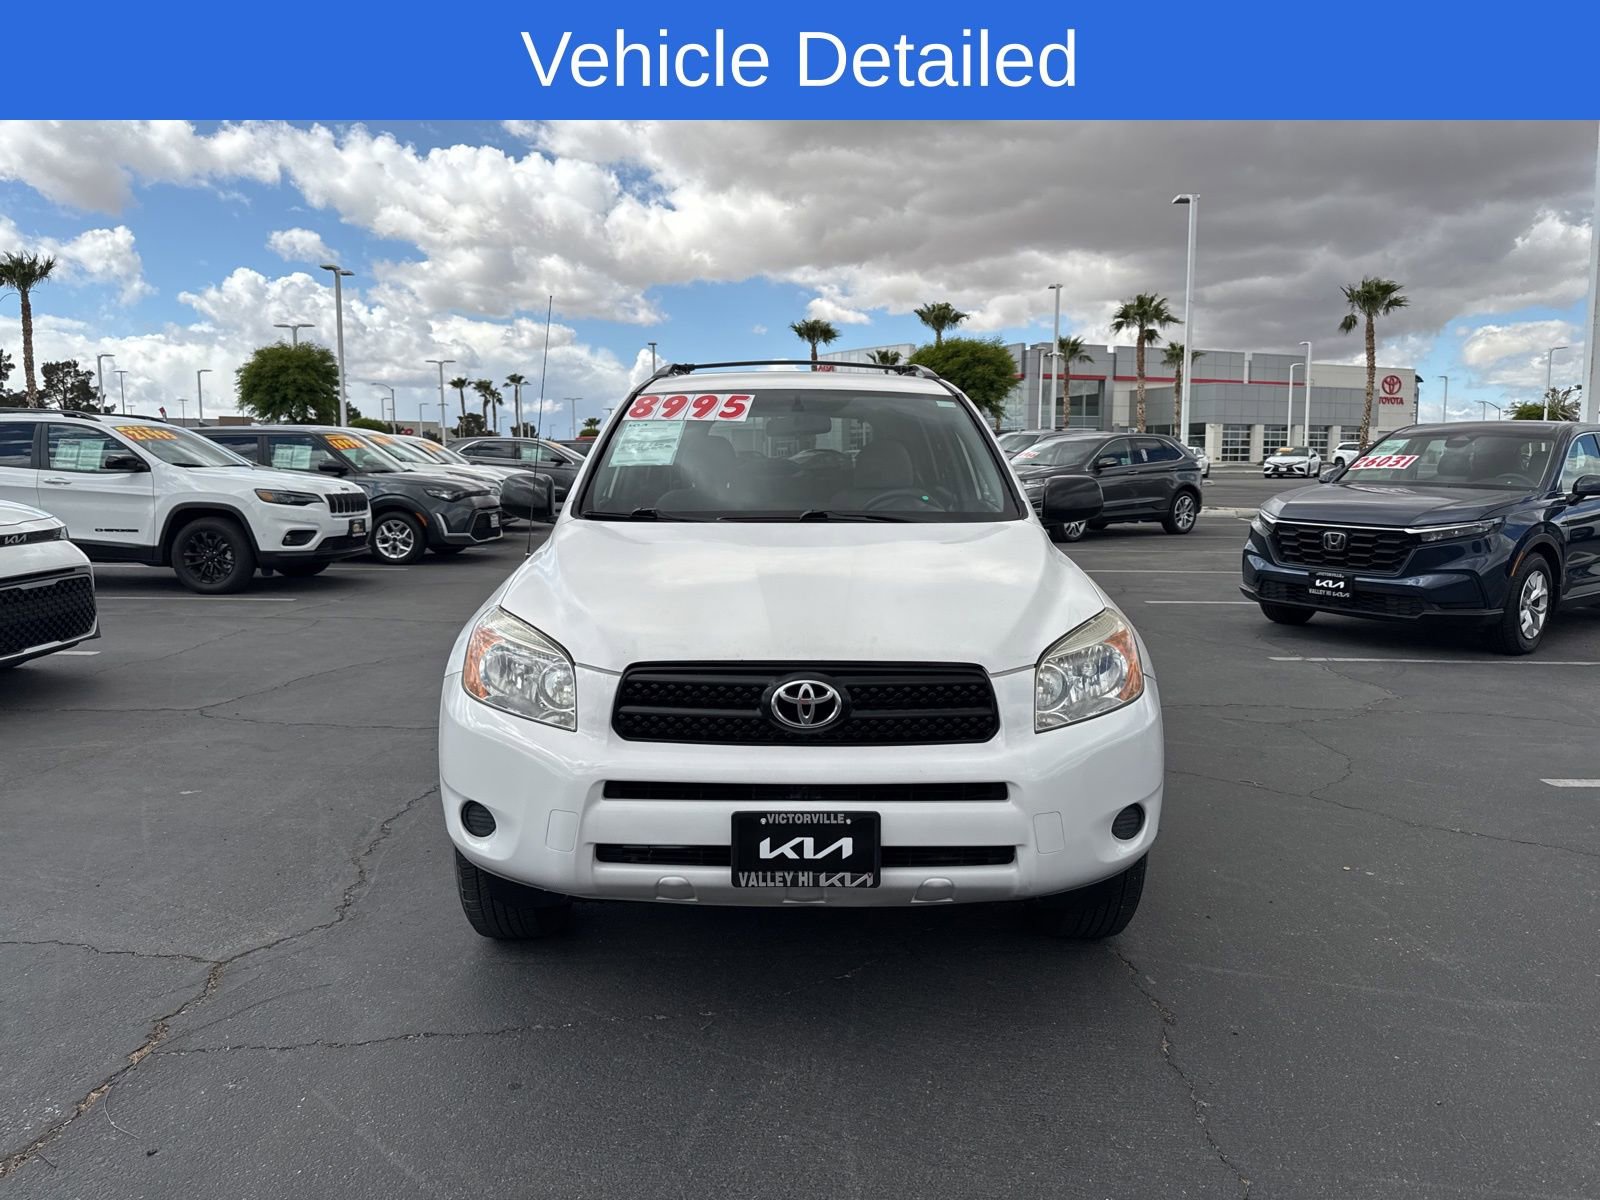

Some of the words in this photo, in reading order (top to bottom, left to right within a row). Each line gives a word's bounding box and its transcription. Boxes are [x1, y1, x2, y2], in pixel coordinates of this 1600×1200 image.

[628, 394, 752, 420] 8995
[1378, 396, 1405, 405] TOYOTA
[1351, 455, 1417, 469] 26031
[4, 533, 28, 545] KIA
[1315, 579, 1345, 589] KIA
[766, 813, 845, 824] VICTORVILLE
[759, 836, 853, 860] KIA
[738, 871, 794, 887] VALLEY
[798, 871, 814, 887] HI
[819, 871, 874, 887] KIA
